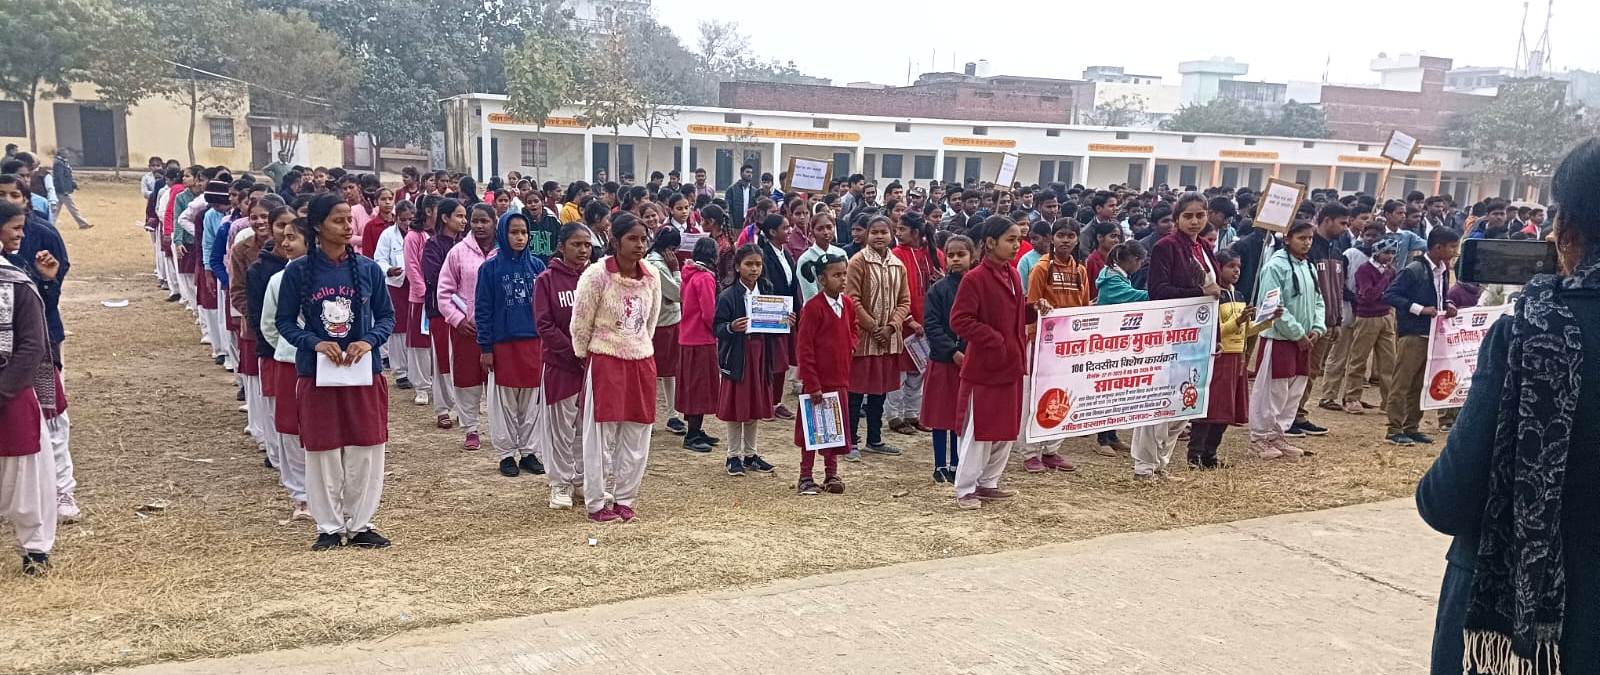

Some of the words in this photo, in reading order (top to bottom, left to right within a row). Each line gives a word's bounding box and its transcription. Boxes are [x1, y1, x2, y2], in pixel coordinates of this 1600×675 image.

[1055, 340, 1087, 356] बाल
[1089, 334, 1130, 351] विवाह
[1132, 331, 1163, 352] मुक्त
[1166, 328, 1200, 344] भारत
[1086, 359, 1119, 372] दिवसीय
[1120, 355, 1143, 368] विशेष
[1094, 374, 1154, 393] सावधान
